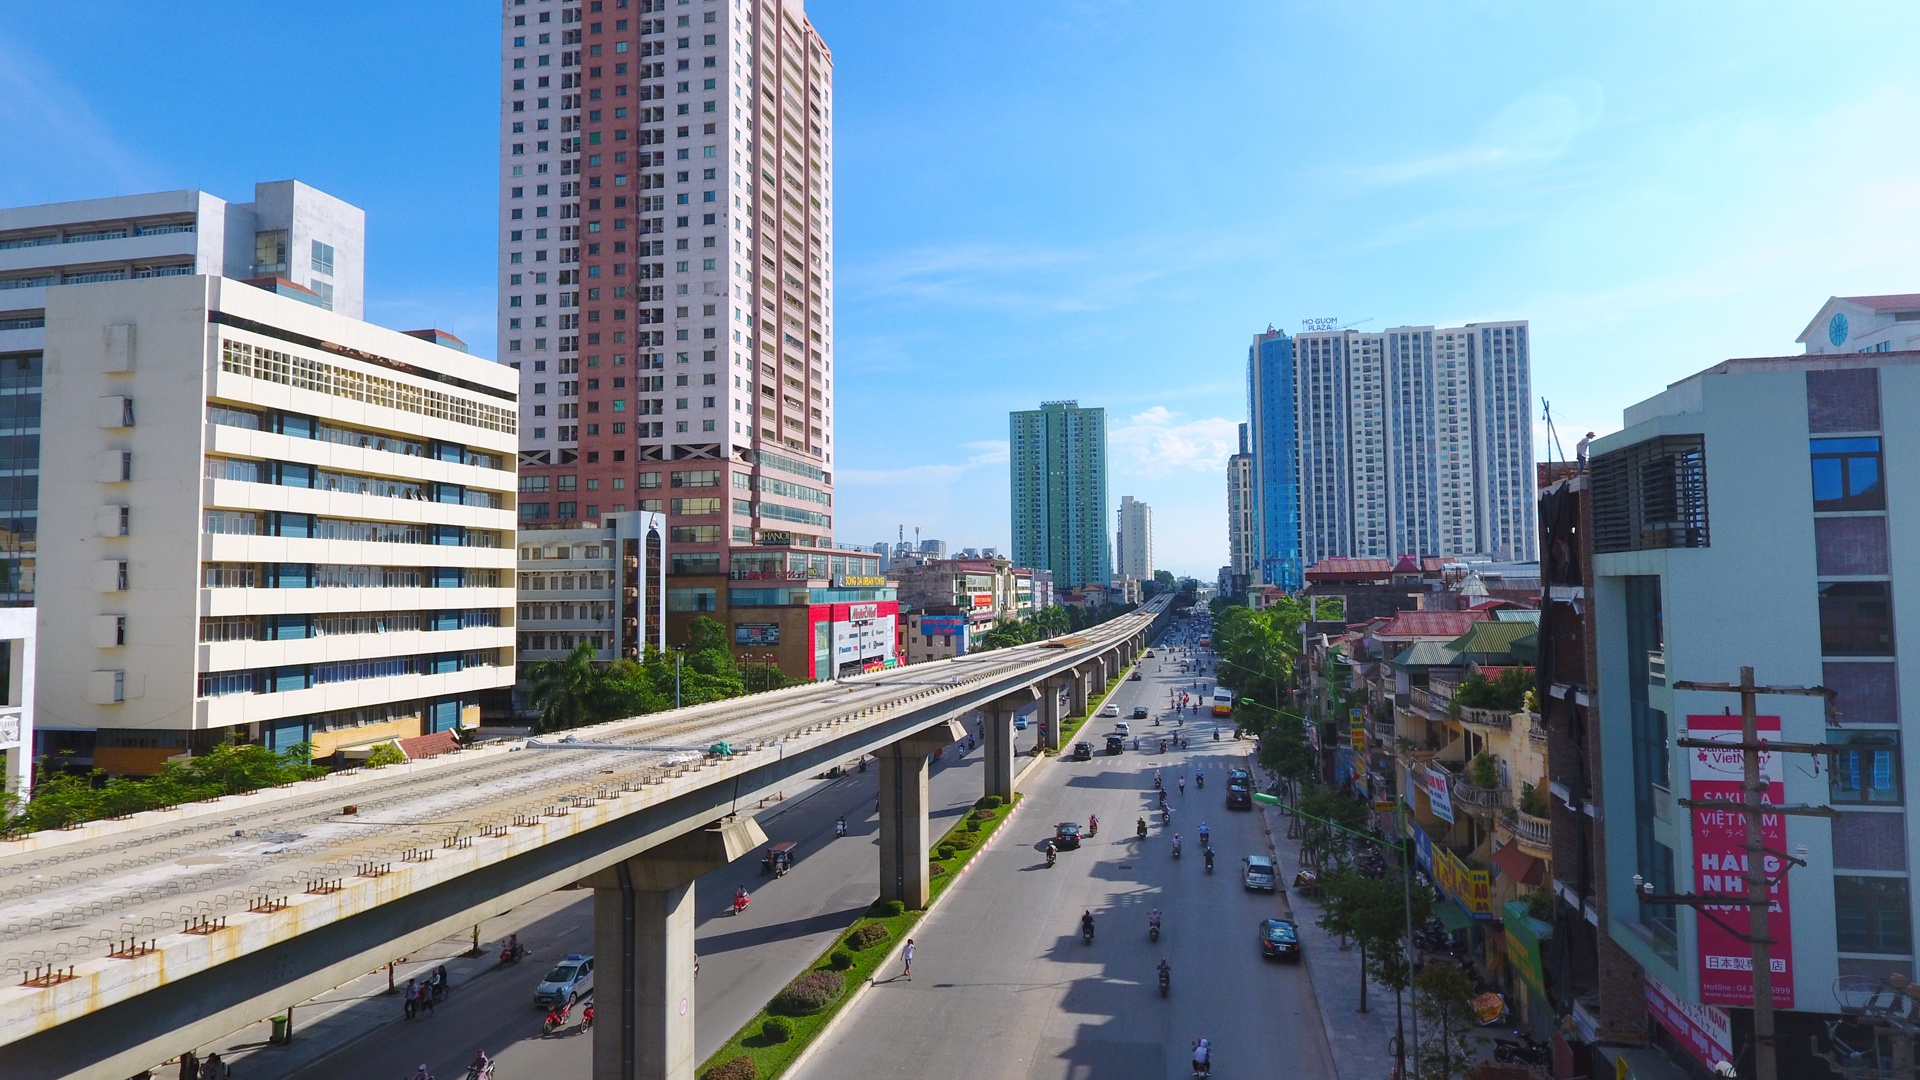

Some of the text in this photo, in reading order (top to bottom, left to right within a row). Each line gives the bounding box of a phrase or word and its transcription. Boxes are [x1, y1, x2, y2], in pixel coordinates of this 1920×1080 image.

[1315, 317, 1338, 325] GUOM
[763, 531, 790, 542] HANOI
[845, 576, 856, 586] SONG
[1712, 753, 1765, 764] VietNm
[1703, 791, 1772, 805] SAKUA
[1700, 810, 1777, 829] VIỆT NM
[1703, 875, 1781, 894] NHT
[1703, 983, 1731, 991] Hotline
